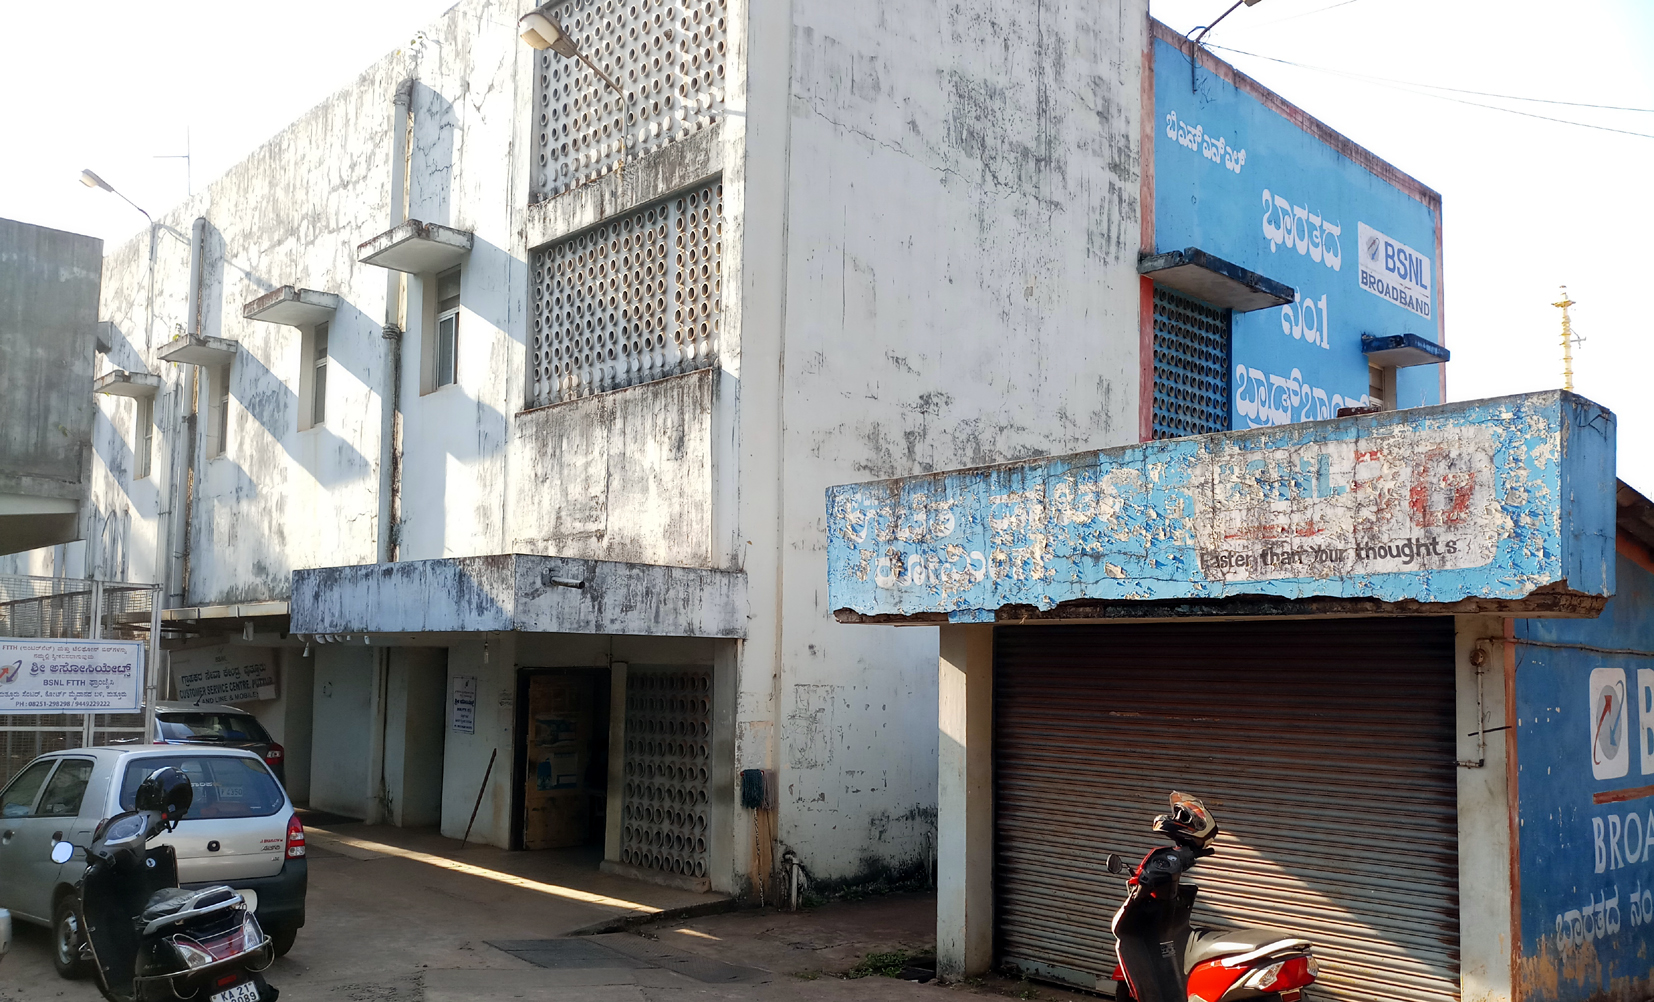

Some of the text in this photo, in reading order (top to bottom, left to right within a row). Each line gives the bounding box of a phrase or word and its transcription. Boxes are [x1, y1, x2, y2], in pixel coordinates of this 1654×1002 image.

[1262, 189, 1341, 271] ಭಾರತದ
[1384, 240, 1428, 290] BSNL
[1361, 269, 1430, 317] BROADBAND
[29, 662, 46, 676] ಶ್ರೀ
[179, 686, 207, 699] CUSTOMER
[207, 683, 228, 696] SERVICE
[221, 984, 250, 1002] KA 21
